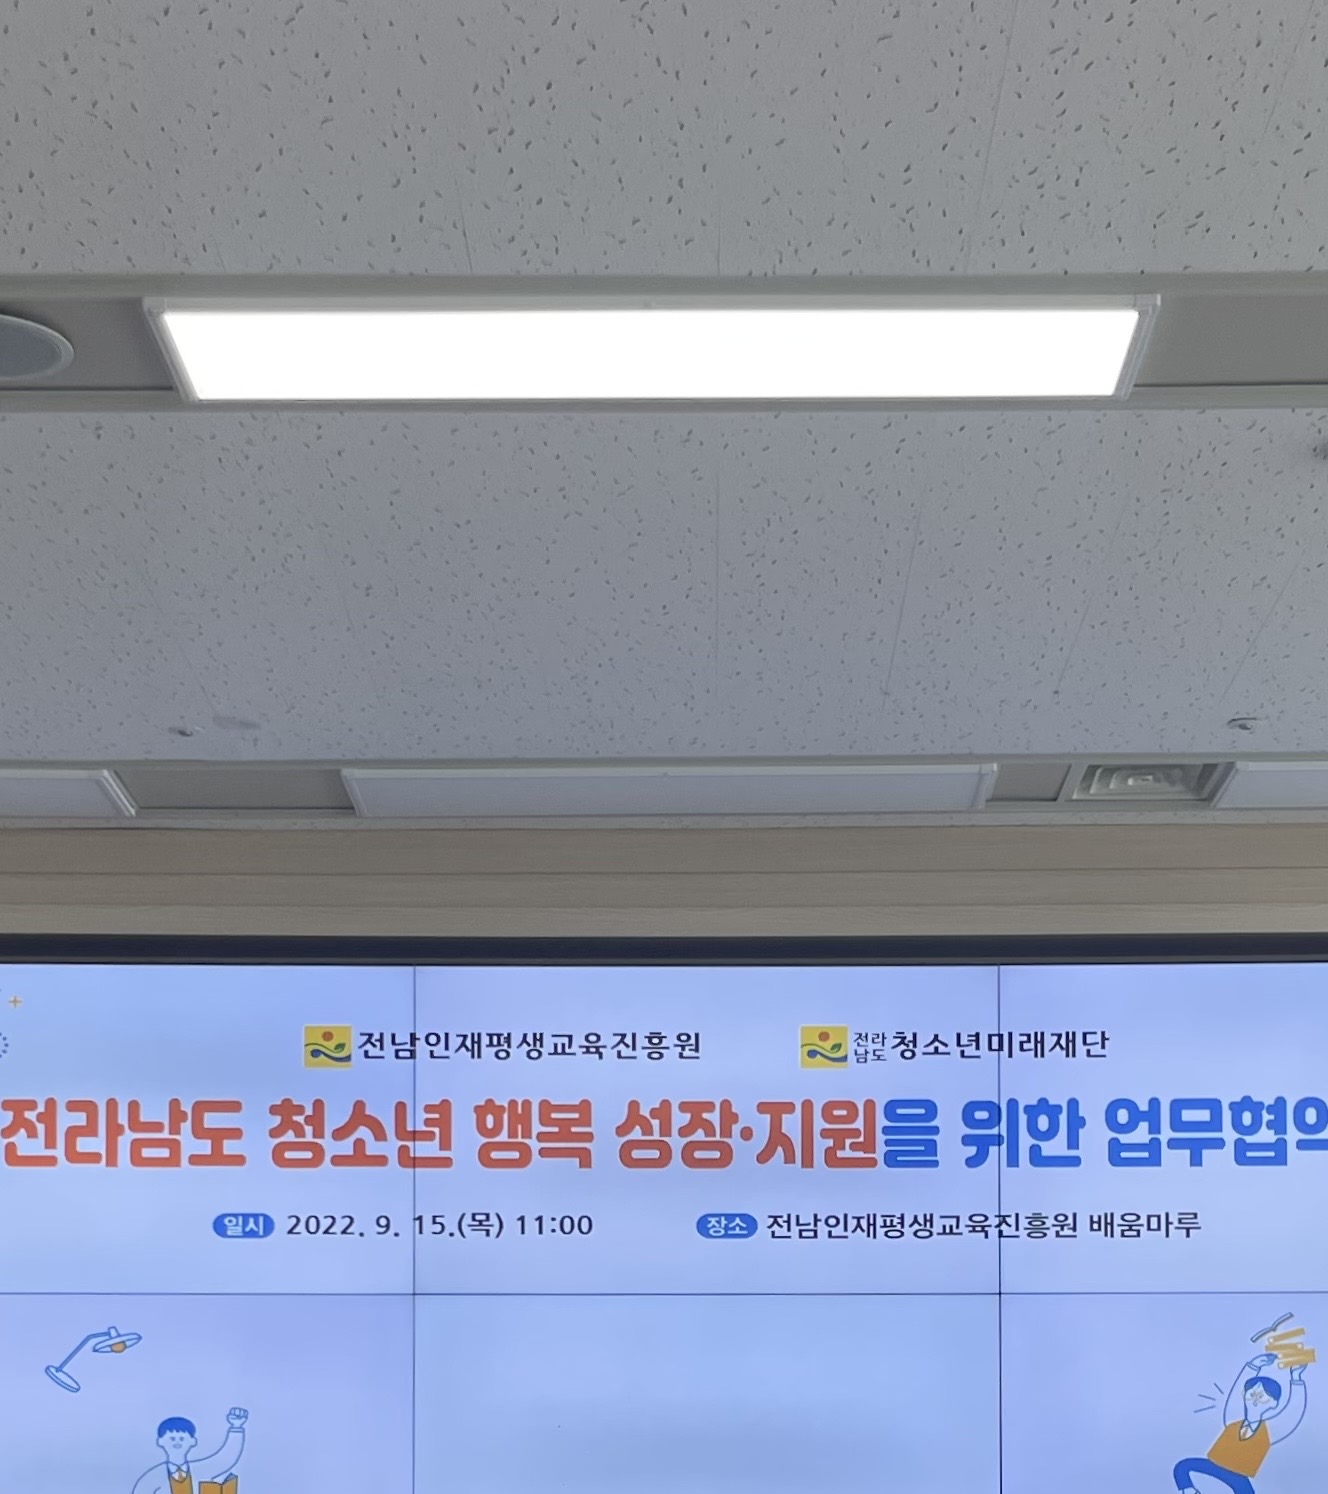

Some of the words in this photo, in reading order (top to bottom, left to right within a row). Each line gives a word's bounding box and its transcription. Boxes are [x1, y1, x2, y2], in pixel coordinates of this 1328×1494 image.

[357, 1031, 701, 1061] 전남인재평생교육진흥원
[853, 1031, 888, 1048] 전라
[891, 1030, 1110, 1060] 청소년미래재단
[853, 1048, 888, 1064] 남도
[0, 1097, 247, 1168] 전라남도
[268, 1097, 454, 1170] 청소년
[473, 1097, 595, 1170] 행복
[960, 1096, 1087, 1168] 위한
[223, 1215, 265, 1237] 일시
[286, 1214, 365, 1238] 2022.
[375, 1214, 400, 1238] 9.
[516, 1214, 594, 1236] 11:00
[706, 1215, 749, 1237] 장소
[766, 1212, 1079, 1240] 전남인재평생교육진흥원
[1089, 1211, 1202, 1239] 배움마루
